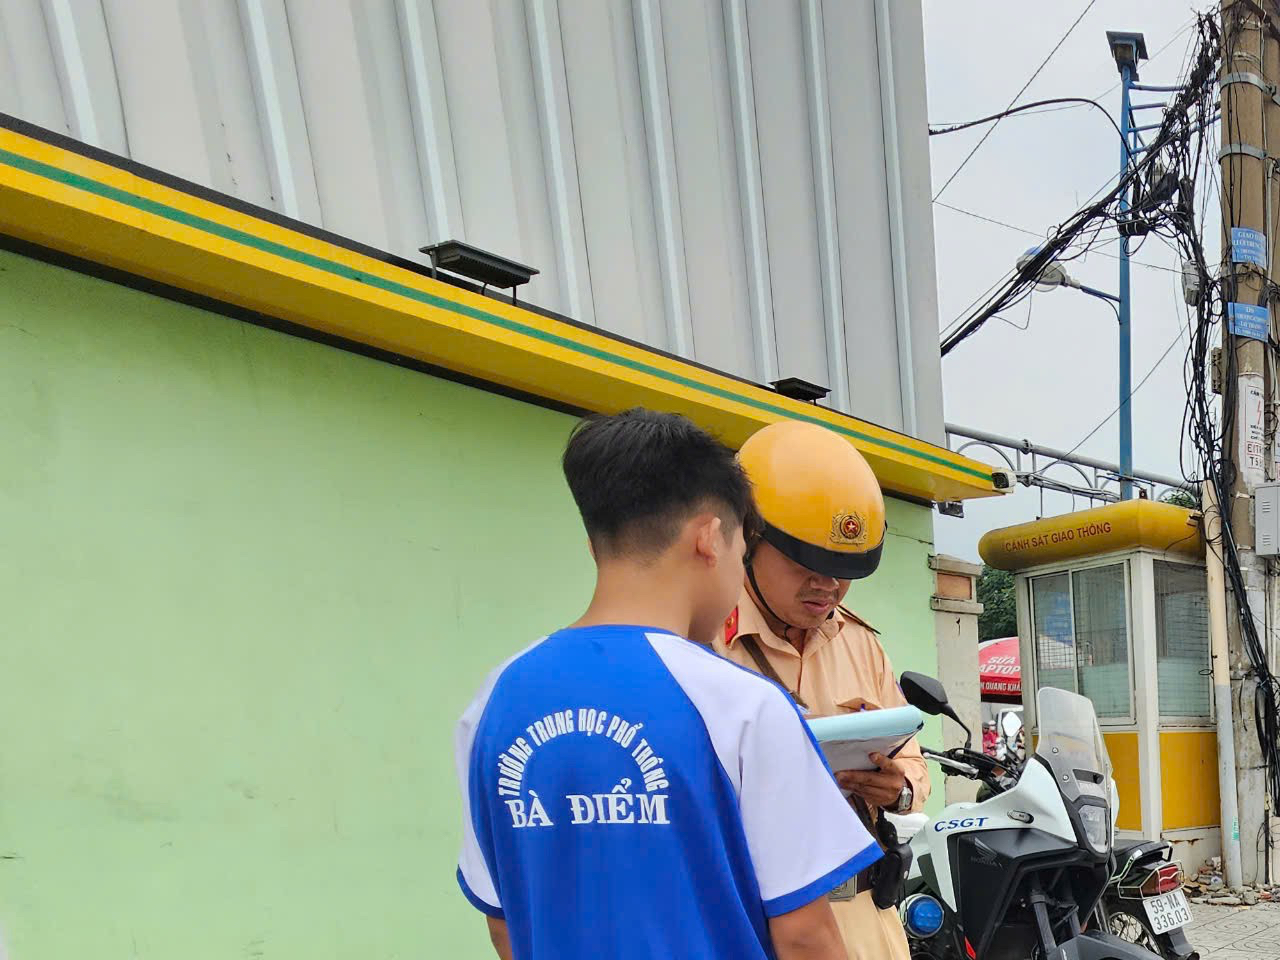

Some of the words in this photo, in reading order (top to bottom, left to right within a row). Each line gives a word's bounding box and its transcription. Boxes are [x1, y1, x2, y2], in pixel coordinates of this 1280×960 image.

[1052, 529, 1074, 544] GIAO
[1076, 522, 1112, 538] THÔNG
[980, 664, 1021, 675] APTOP
[986, 682, 1006, 690] QUANG
[498, 737, 534, 797] TRƯỜNG
[526, 709, 574, 746] TRUNG
[578, 708, 607, 736] HỌC
[606, 715, 644, 748] PHỔ
[632, 738, 670, 792] THÔNG
[505, 790, 554, 828] BÀ
[566, 778, 670, 824] ĐIỂM
[1150, 894, 1181, 914] 59-NA
[1154, 908, 1189, 930] 336.03
